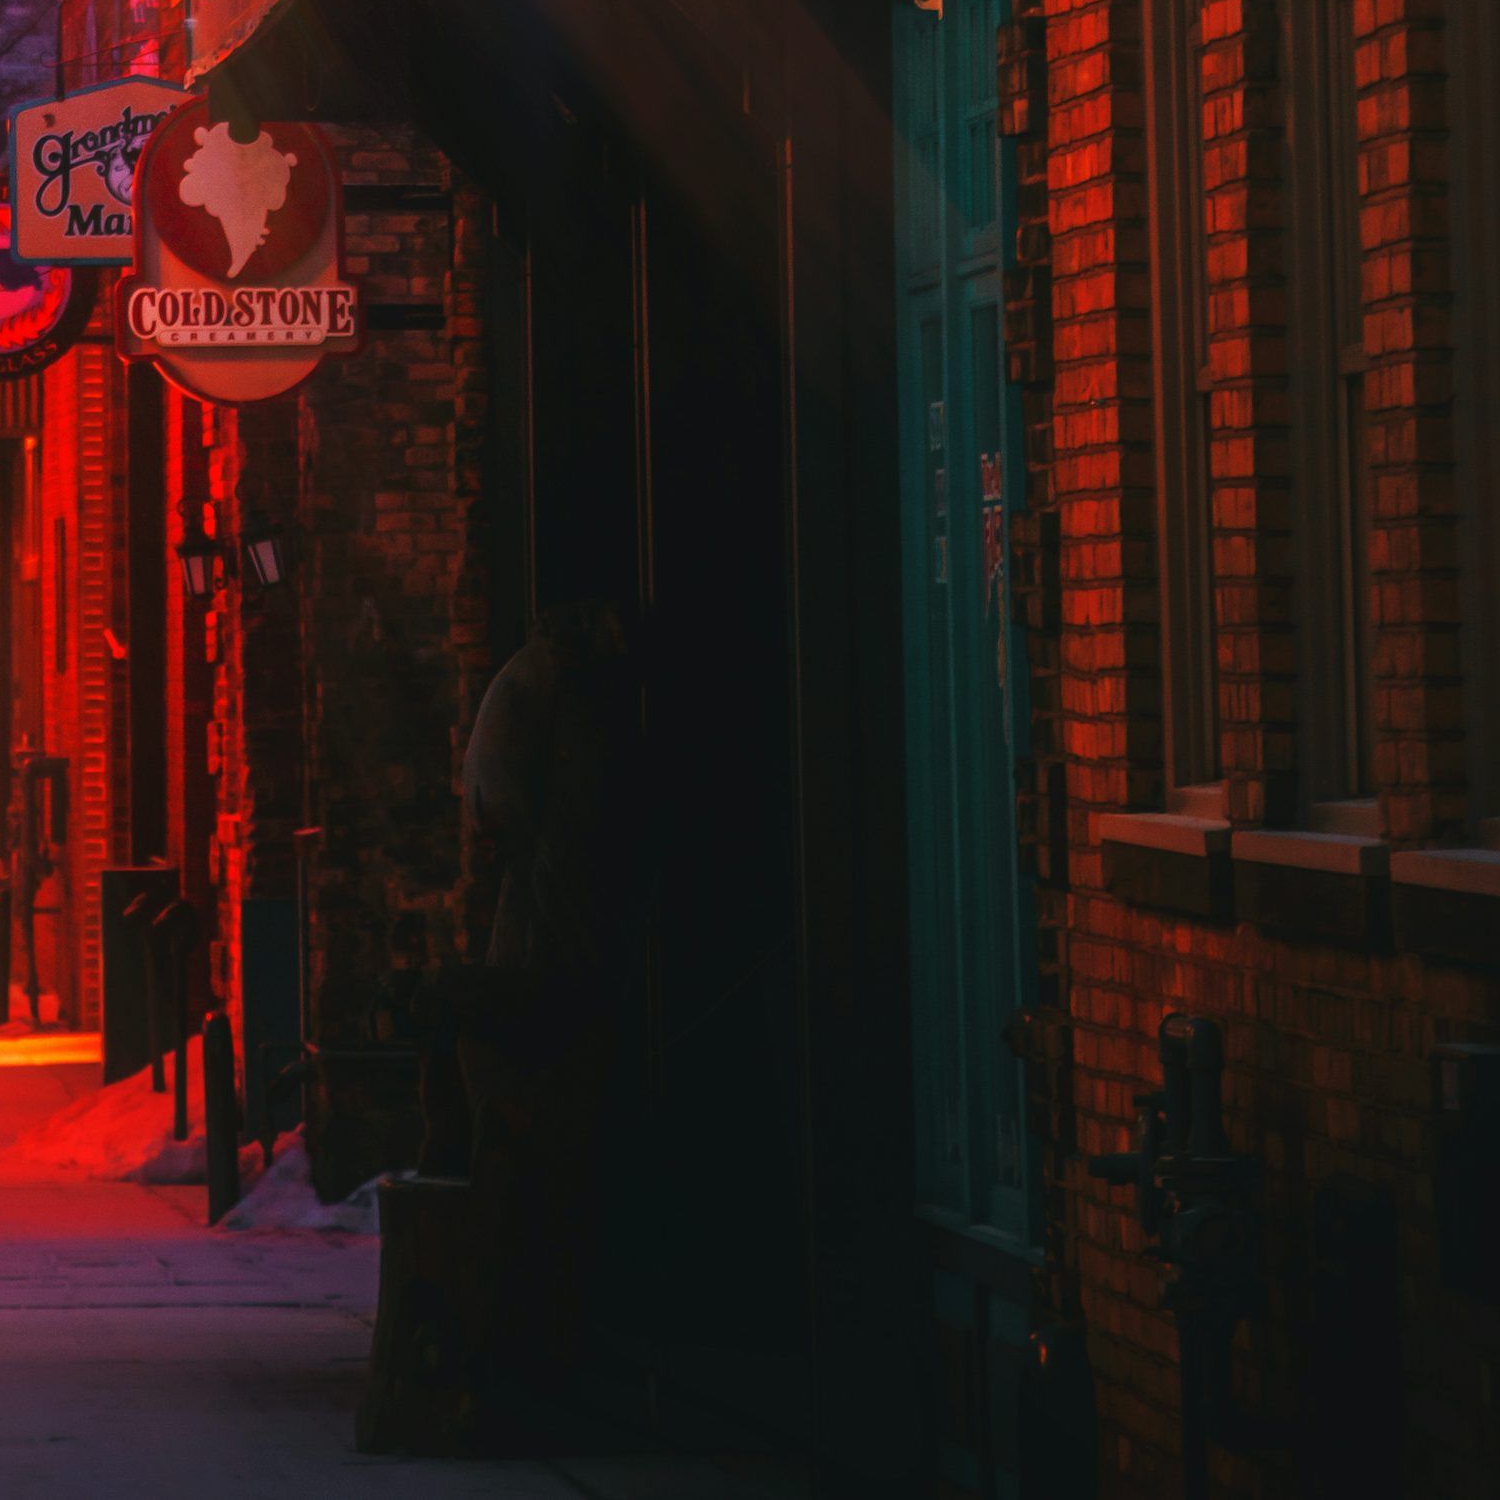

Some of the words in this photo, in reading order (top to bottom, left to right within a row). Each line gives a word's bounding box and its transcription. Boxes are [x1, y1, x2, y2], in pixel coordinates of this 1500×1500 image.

[131, 290, 226, 337] COLD
[233, 289, 351, 334] STONE
[170, 330, 313, 343] CREAMERY
